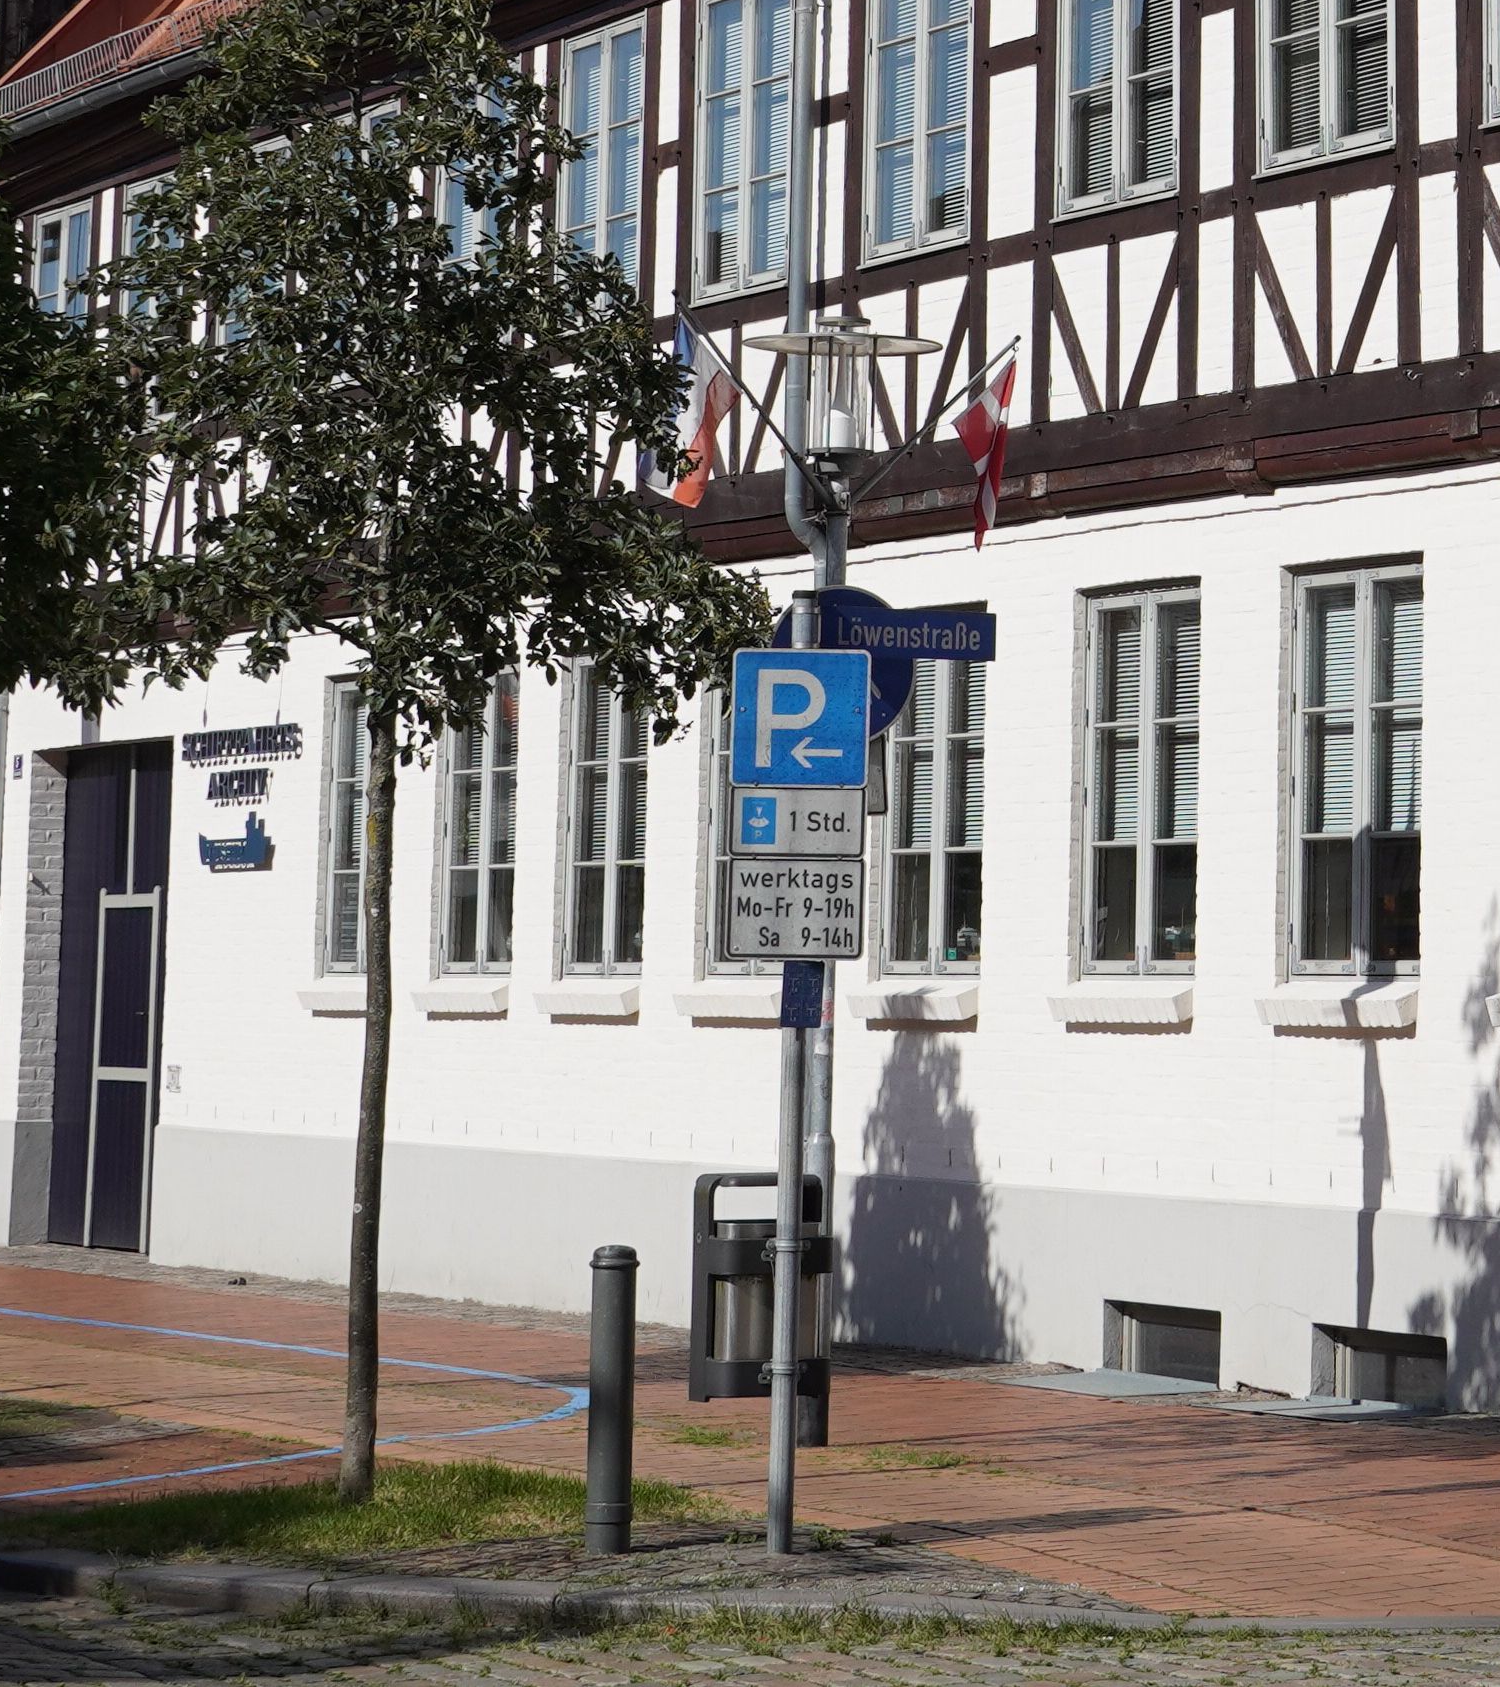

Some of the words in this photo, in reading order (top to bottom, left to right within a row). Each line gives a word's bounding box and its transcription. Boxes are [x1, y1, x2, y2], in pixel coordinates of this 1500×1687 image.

[837, 616, 981, 651] Löwenstraße
[755, 668, 827, 768] P
[206, 768, 270, 800] ARCHIV
[789, 811, 797, 832] 1
[806, 811, 851, 833] Std.
[740, 867, 854, 894] werktags
[737, 896, 793, 918] Mo-Fr
[803, 897, 855, 919] 9-19h
[758, 926, 781, 948] Sa
[801, 926, 854, 949] 9-14h
